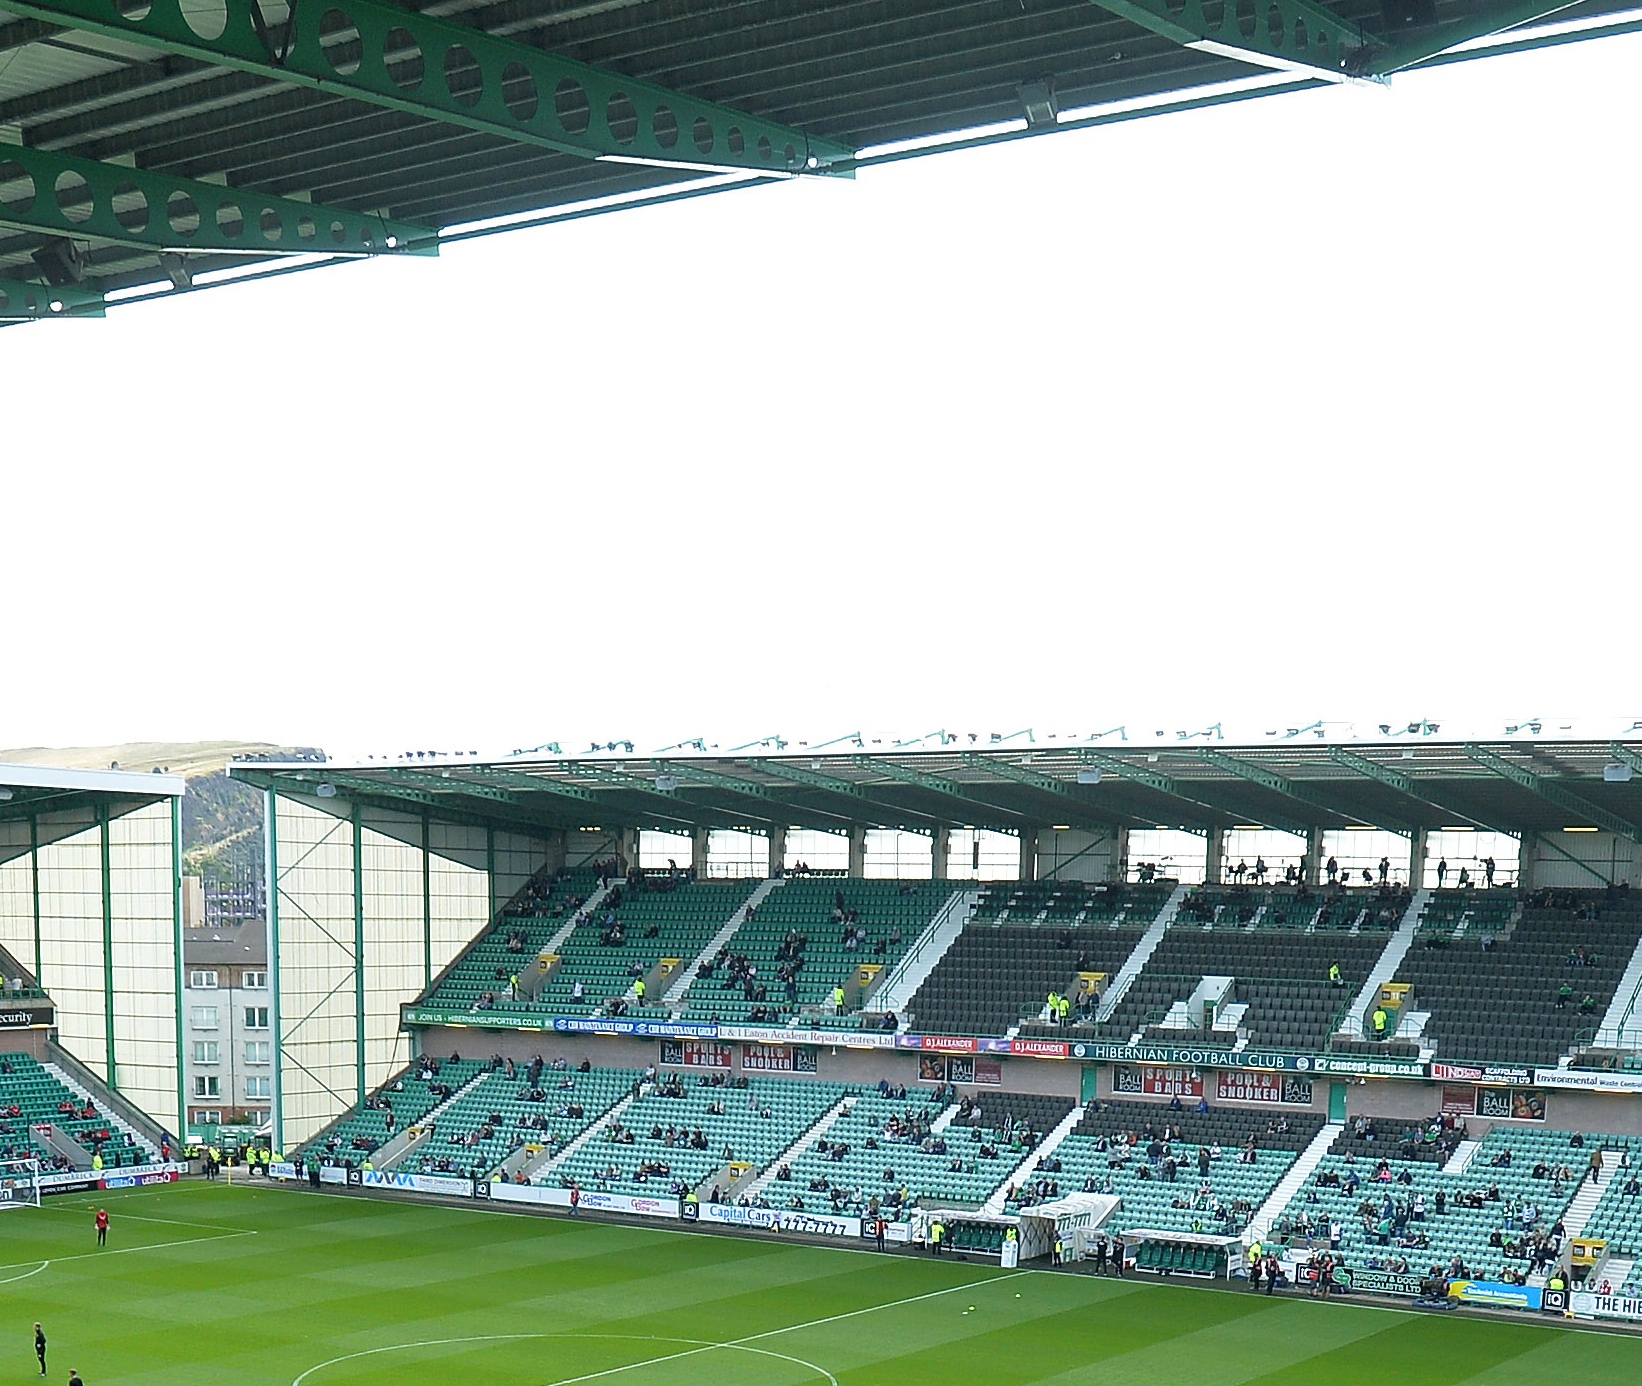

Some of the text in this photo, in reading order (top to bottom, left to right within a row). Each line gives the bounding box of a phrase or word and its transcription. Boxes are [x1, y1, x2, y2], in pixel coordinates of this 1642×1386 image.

[728, 1028, 737, 1037] &
[771, 1029, 807, 1040] Accident
[810, 1031, 837, 1042] Repair
[842, 1032, 875, 1044] Centres
[879, 1035, 894, 1046] Ltd
[750, 1046, 775, 1056] POOL
[1096, 1046, 1284, 1068] HIBERNIAN FOOTBALL CLUB
[693, 1054, 723, 1065] BARS
[744, 1056, 790, 1069] SNOOKER
[1330, 1061, 1424, 1075] concept-group.co.uk
[1228, 1072, 1259, 1086] POOL
[1537, 1073, 1597, 1085] Environmental
[1155, 1082, 1192, 1095] BARS
[1220, 1085, 1277, 1100] SNOOKER
[1483, 1098, 1508, 1108] BALL
[1483, 1107, 1508, 1115] ROOM
[710, 1205, 770, 1220] Capital Cars
[1352, 1271, 1386, 1281] WINDOW
[1352, 1279, 1421, 1293] SPECIALISTS LTD
[1595, 1297, 1619, 1311] THE
